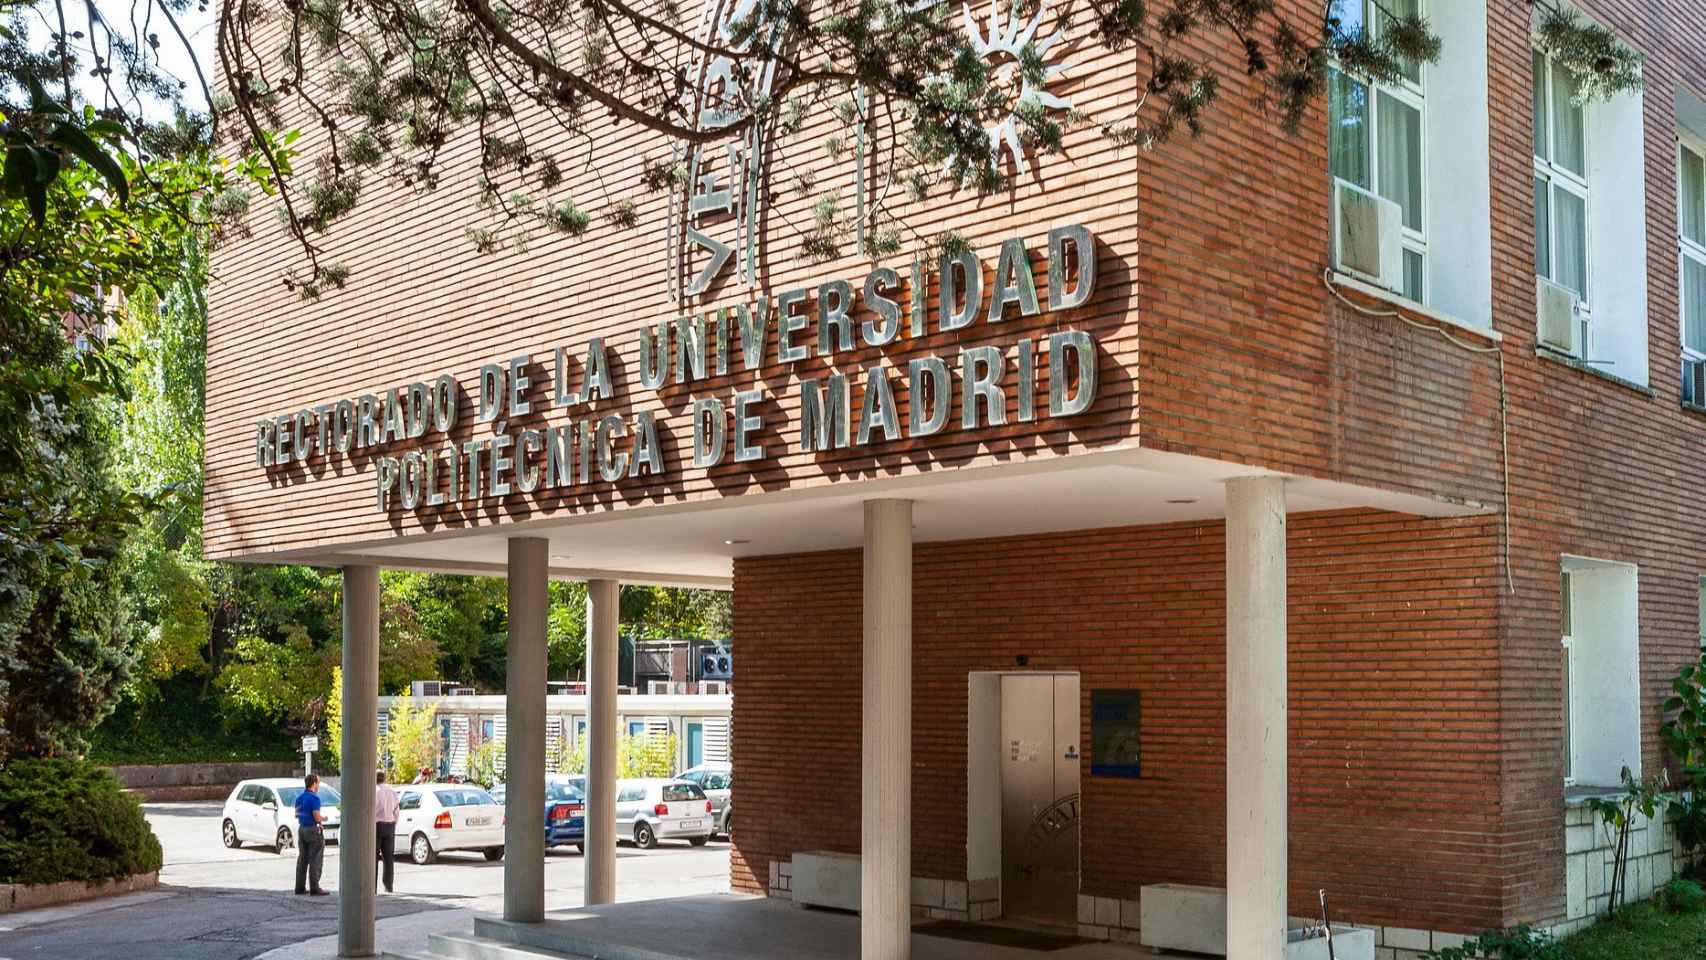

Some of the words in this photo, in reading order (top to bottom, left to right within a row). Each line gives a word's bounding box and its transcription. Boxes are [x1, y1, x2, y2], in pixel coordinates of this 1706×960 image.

[256, 373, 459, 468] RECTORADO
[479, 354, 534, 423] DE
[554, 337, 615, 407] LA
[639, 224, 1099, 391] UNIVERSIDAD
[377, 410, 665, 512] POLITÉCNICA
[693, 389, 766, 469] DE
[800, 330, 1099, 453] MADRID
